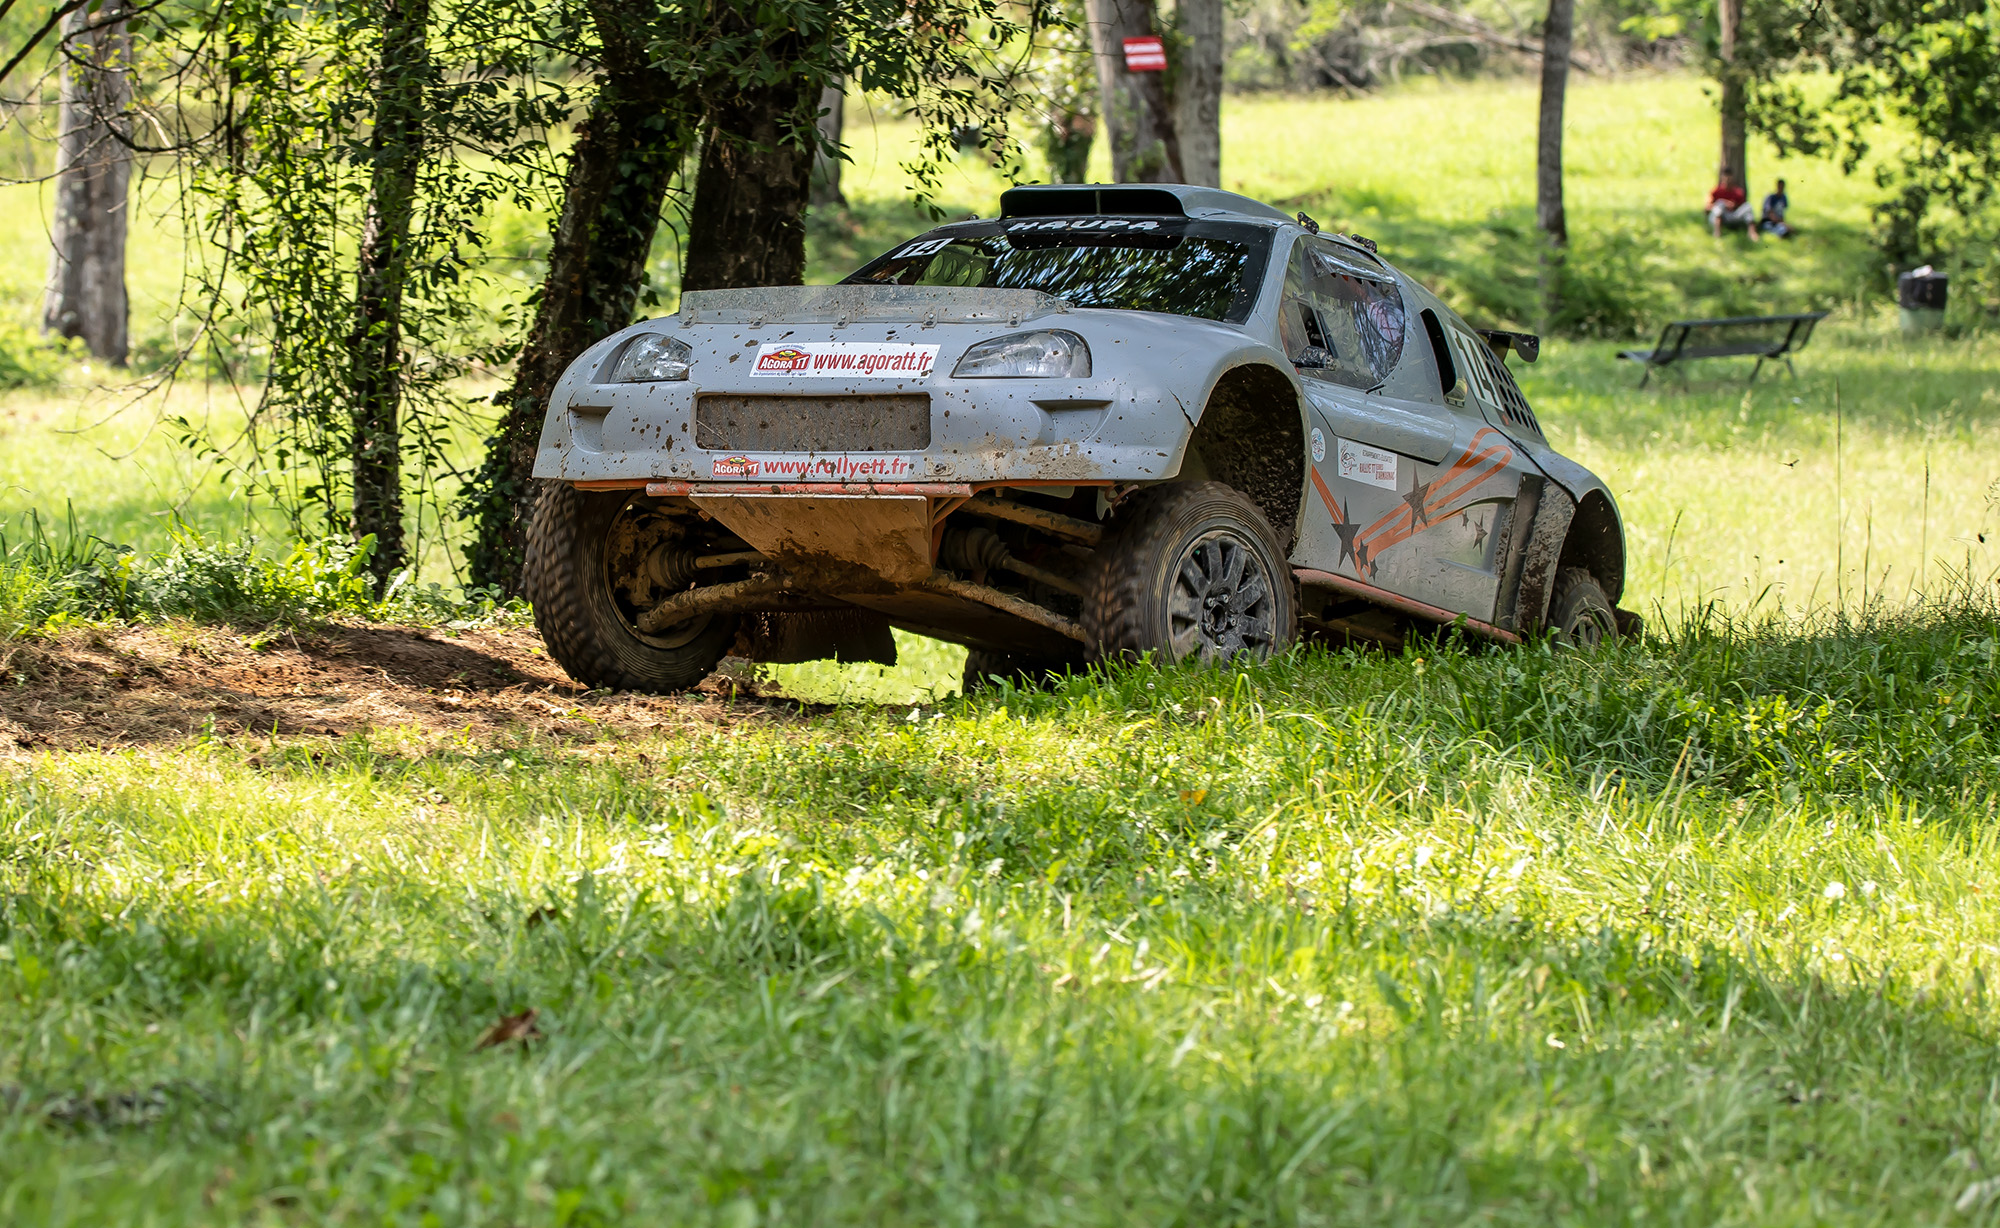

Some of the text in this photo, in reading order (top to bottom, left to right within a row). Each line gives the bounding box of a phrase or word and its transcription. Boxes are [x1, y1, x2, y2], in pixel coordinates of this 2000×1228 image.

[1007, 220, 1159, 231] HAUPA
[760, 357, 793, 369] AGORA
[813, 352, 932, 374] www.agoratt.fr
[1454, 330, 1500, 407] 14
[714, 463, 745, 474] AGORA
[763, 457, 908, 477] www.rallyett.fr
